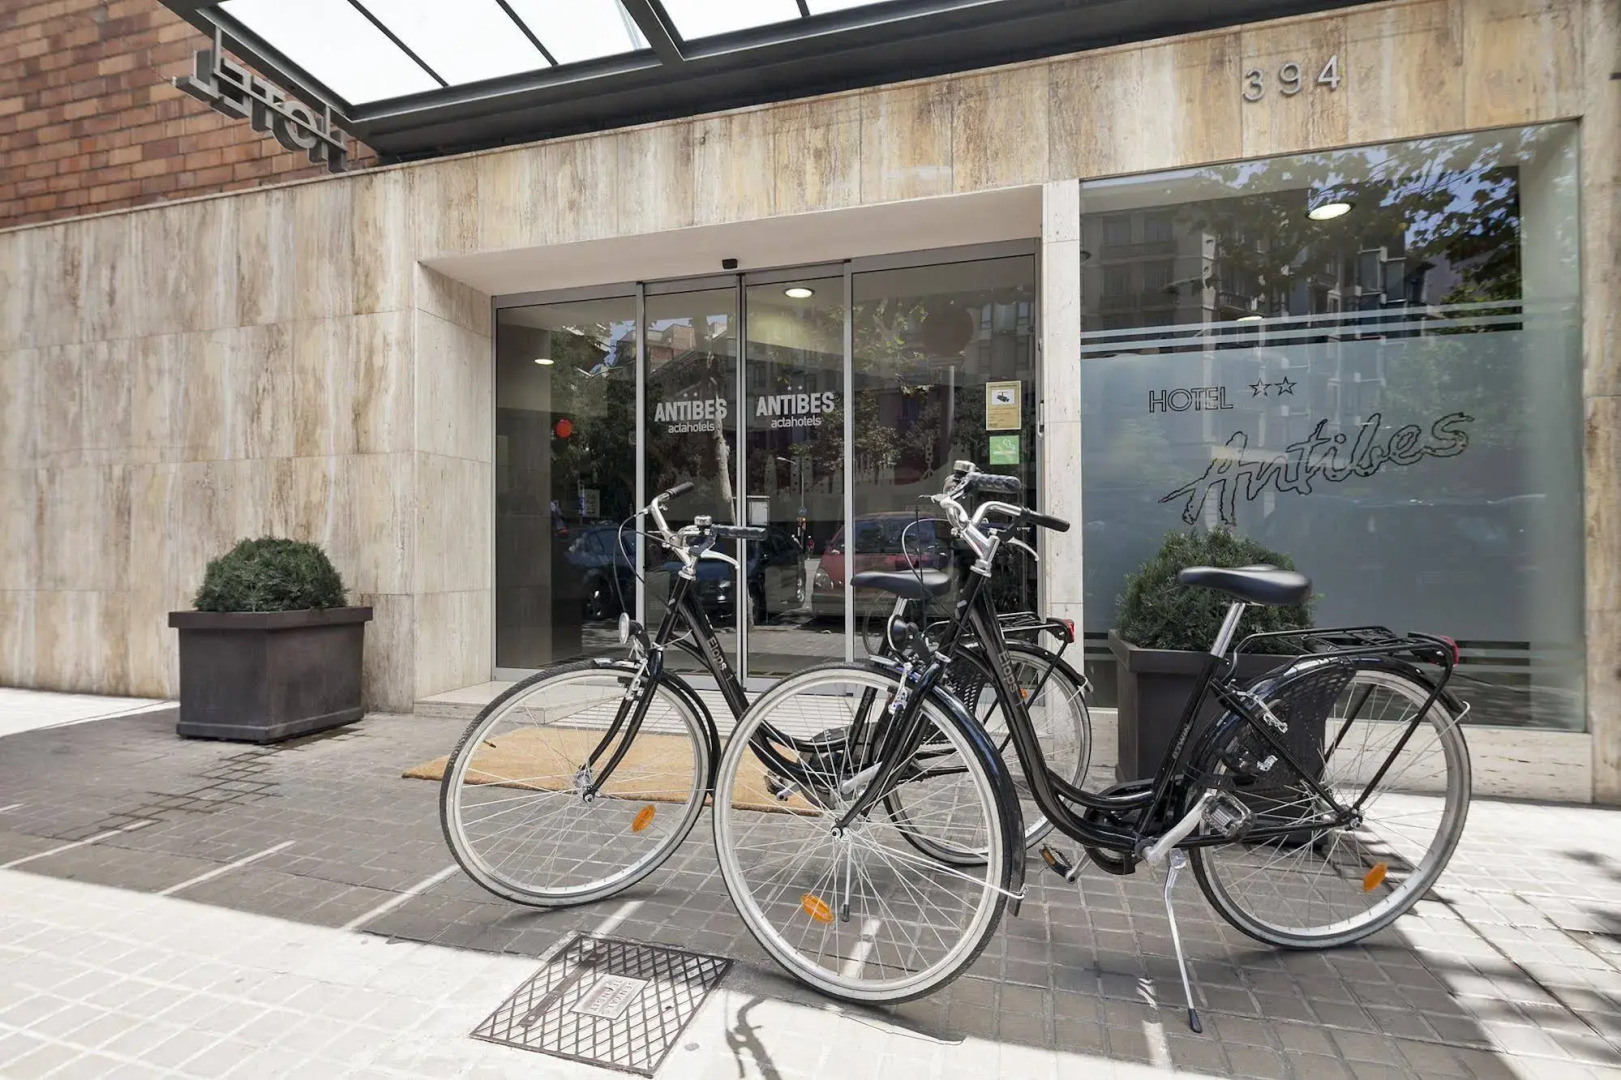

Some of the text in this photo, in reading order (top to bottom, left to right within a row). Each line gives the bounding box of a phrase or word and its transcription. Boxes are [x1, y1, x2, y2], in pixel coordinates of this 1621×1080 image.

[1242, 54, 1341, 101] 394
[654, 398, 727, 422] ANTIBES
[756, 391, 835, 417] ANTIBES
[1149, 386, 1234, 413] HOTEL
[668, 420, 715, 434] actahotels
[771, 414, 822, 428] actahotels
[1158, 412, 1475, 527] Antibes
[706, 636, 727, 671] Elops
[998, 650, 1018, 693] Elops
